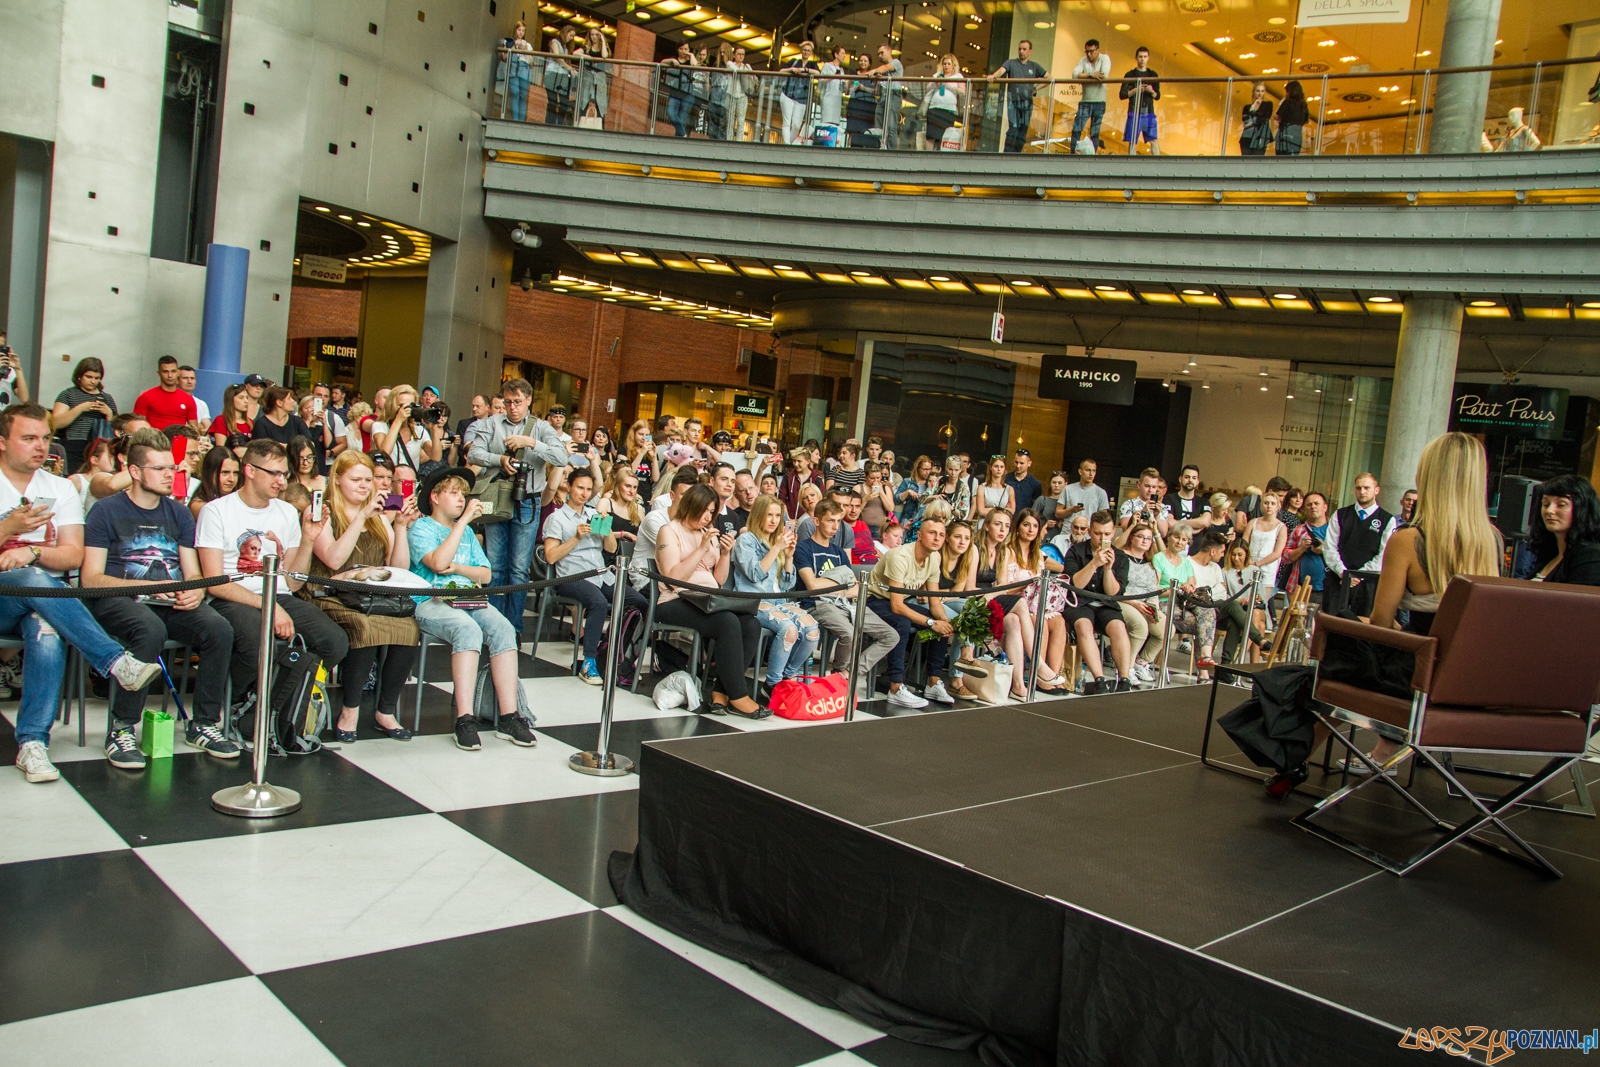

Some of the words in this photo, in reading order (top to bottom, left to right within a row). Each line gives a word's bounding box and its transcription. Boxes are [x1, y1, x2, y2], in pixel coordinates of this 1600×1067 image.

[322, 344, 336, 356] SO!
[1054, 369, 1121, 383] KARPICKO
[1456, 394, 1503, 417] Petit
[1506, 397, 1556, 422] Paris
[1274, 447, 1324, 458] KARPICKO
[805, 695, 847, 716] adida
